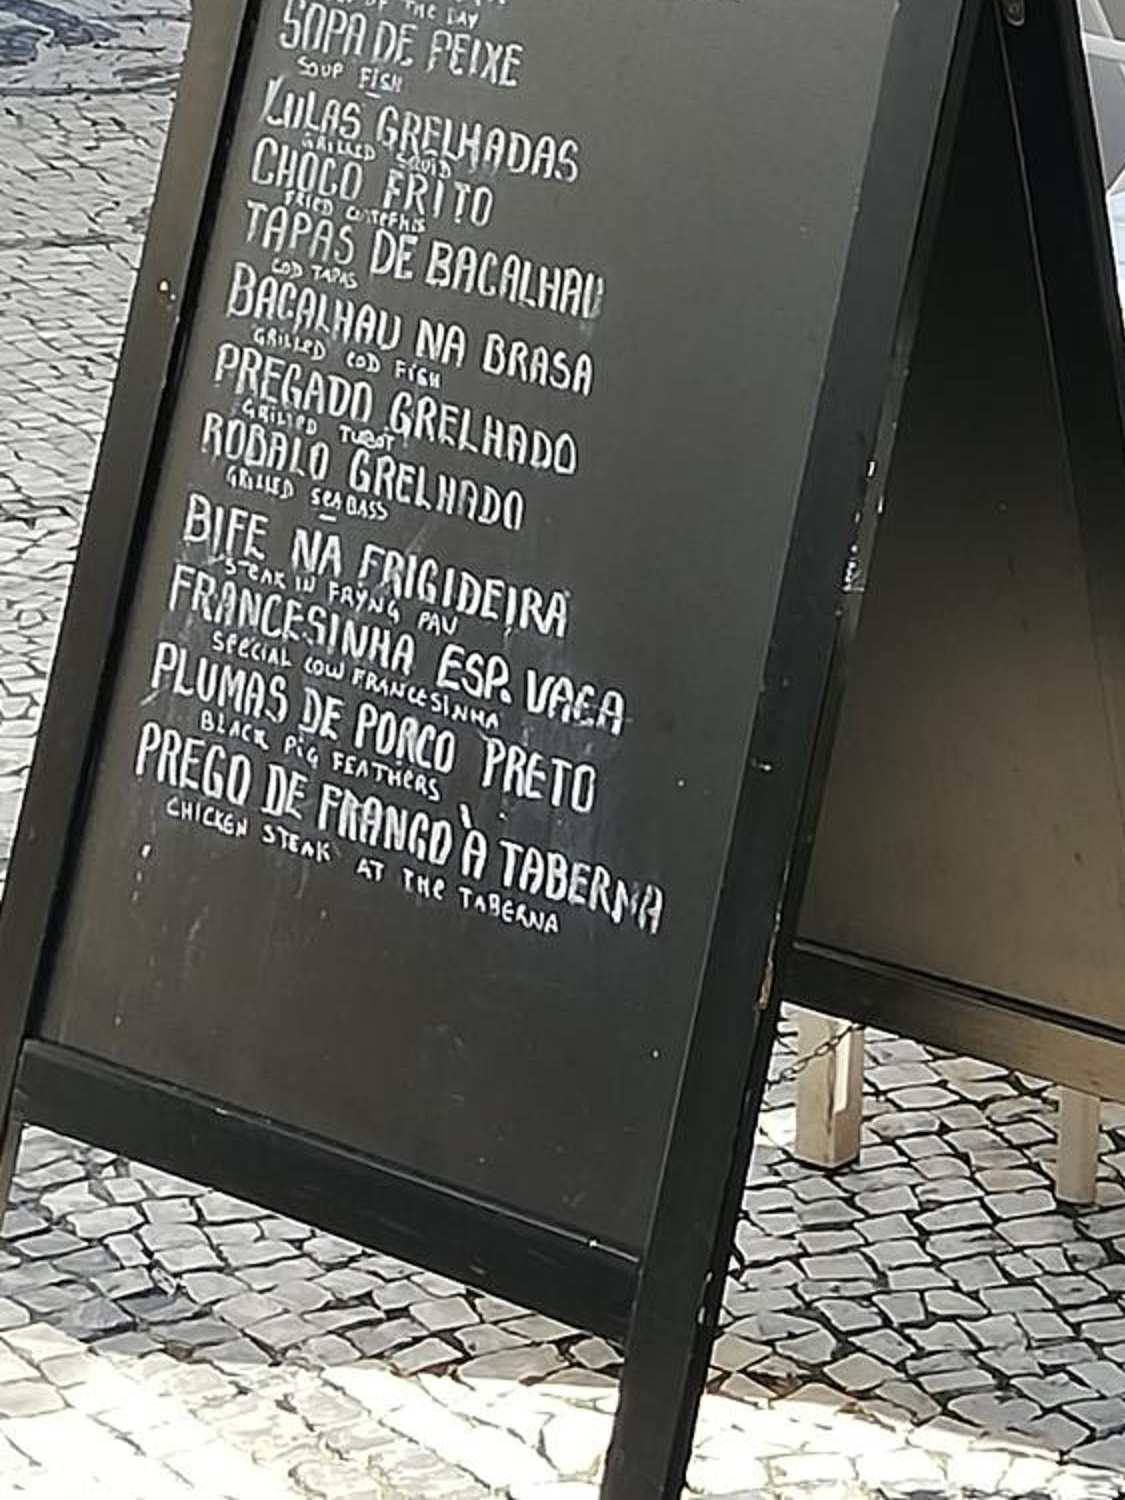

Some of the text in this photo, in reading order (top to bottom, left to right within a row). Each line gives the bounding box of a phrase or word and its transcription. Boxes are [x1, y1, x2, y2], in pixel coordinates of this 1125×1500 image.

[372, 20, 419, 67] DE
[426, 29, 524, 88] PEIXE
[405, 0, 438, 20] THE
[297, 56, 403, 93] SOUP FISH
[263, 77, 580, 183] LULAS GRELHADAS
[302, 133, 376, 161] GRILLED
[250, 137, 495, 228] CHOCO FRITO
[285, 189, 334, 216] FRIED
[246, 199, 605, 320] TAPAS DE BACALHAU
[271, 257, 359, 290] COD TAPAS
[226, 261, 595, 397] BACALHAU NA BRASA
[252, 325, 442, 389] GRILLED COD FISH
[213, 342, 579, 476] PREGADO GRELHADO
[241, 399, 318, 436] GRILLED
[201, 412, 525, 531] ROBALO GRELHADO
[226, 465, 389, 521] GRILLED SEA BASS
[183, 493, 571, 639] BIFE NA FRIGIDEIRA
[224, 557, 287, 590] STEAK
[169, 563, 416, 676] FRANCESINHA
[436, 643, 512, 704] ESP.
[211, 631, 499, 731] SPECIAL COW FRANCESINHA
[151, 642, 596, 813] PLUMAS DE PORCO PRETO
[200, 709, 442, 801] BLACK PIG FEATHERS
[135, 721, 664, 935] PREGO DE FRANGO À TABERNA
[166, 796, 560, 934] CHICKEN STEAK AT THE TABERNA
